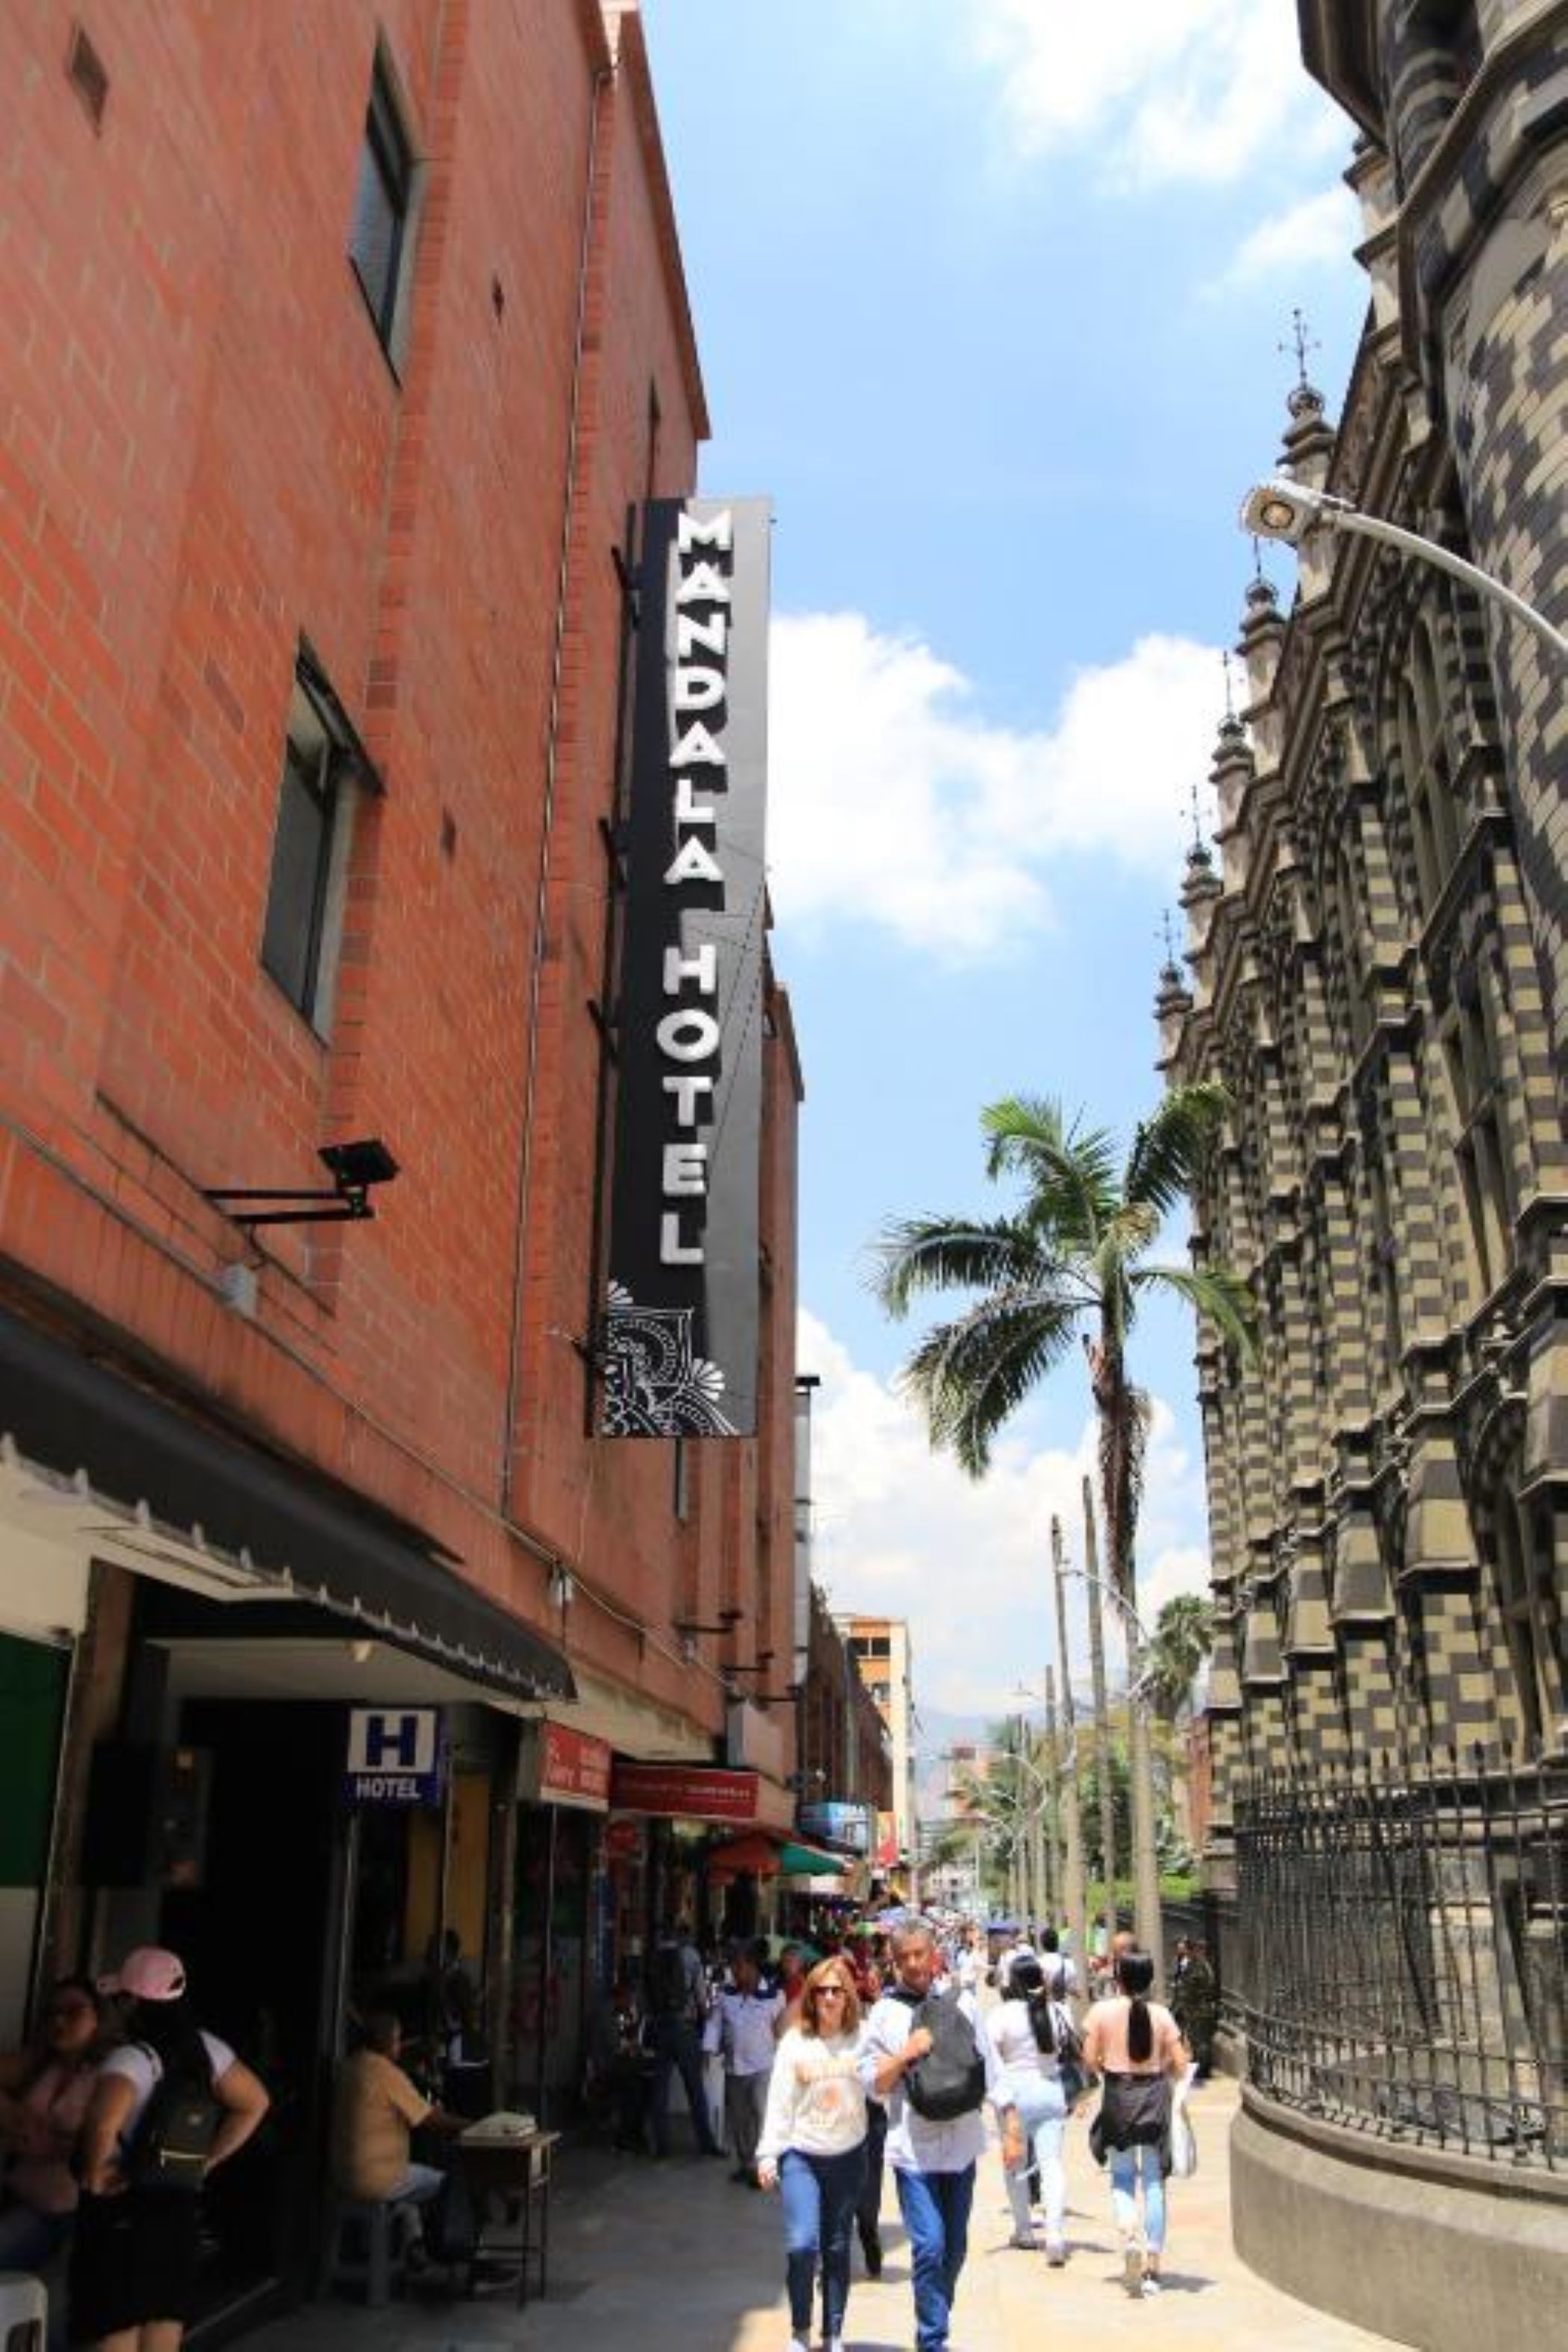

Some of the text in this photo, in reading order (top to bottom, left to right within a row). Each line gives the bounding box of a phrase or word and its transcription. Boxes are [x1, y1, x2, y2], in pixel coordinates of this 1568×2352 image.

[656, 511, 733, 1264] MANDALA HOTEL
[365, 1715, 418, 1766] H
[356, 1777, 422, 1799] HOTEL
